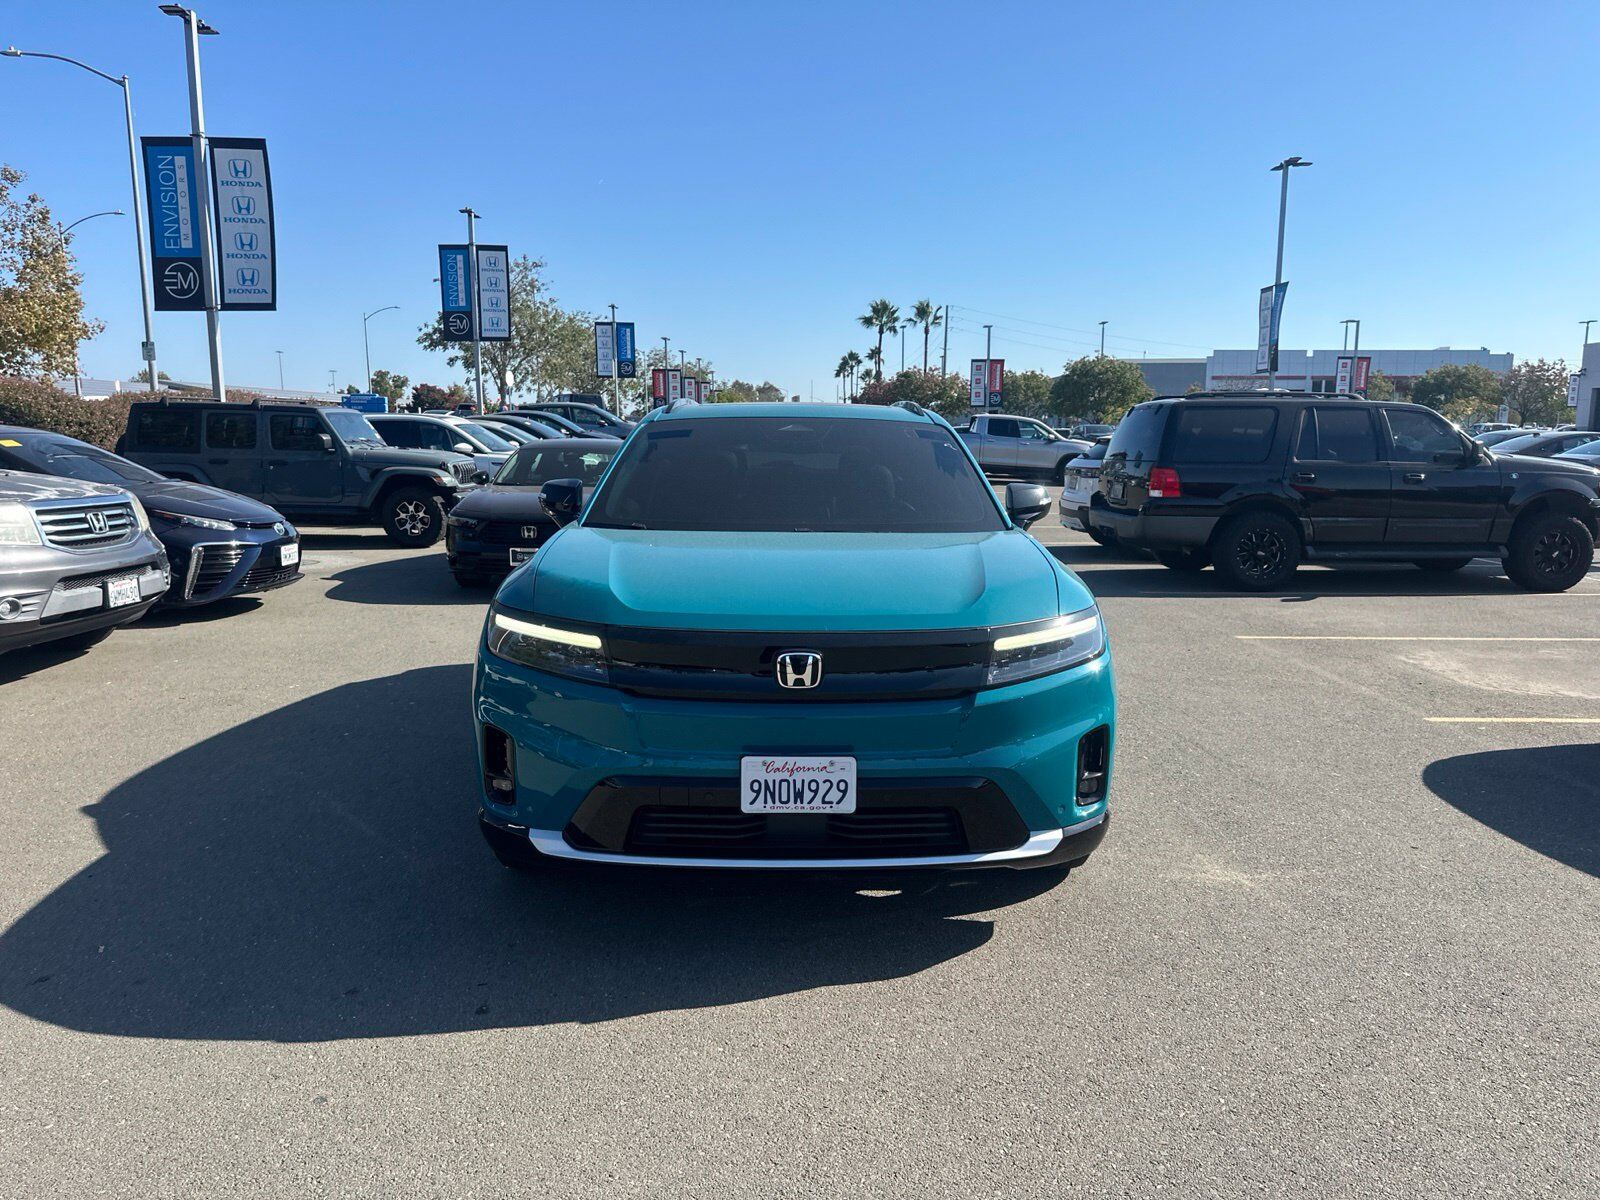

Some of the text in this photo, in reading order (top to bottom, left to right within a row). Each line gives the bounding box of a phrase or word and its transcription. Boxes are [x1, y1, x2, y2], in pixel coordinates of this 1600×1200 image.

[220, 180, 263, 188] HONDA
[157, 155, 181, 249] ENVISION
[177, 164, 191, 241] MOTORS
[223, 217, 266, 225] HONDA
[447, 254, 459, 307] ENVISION
[765, 760, 835, 777] California
[749, 779, 849, 805] 9NOW929
